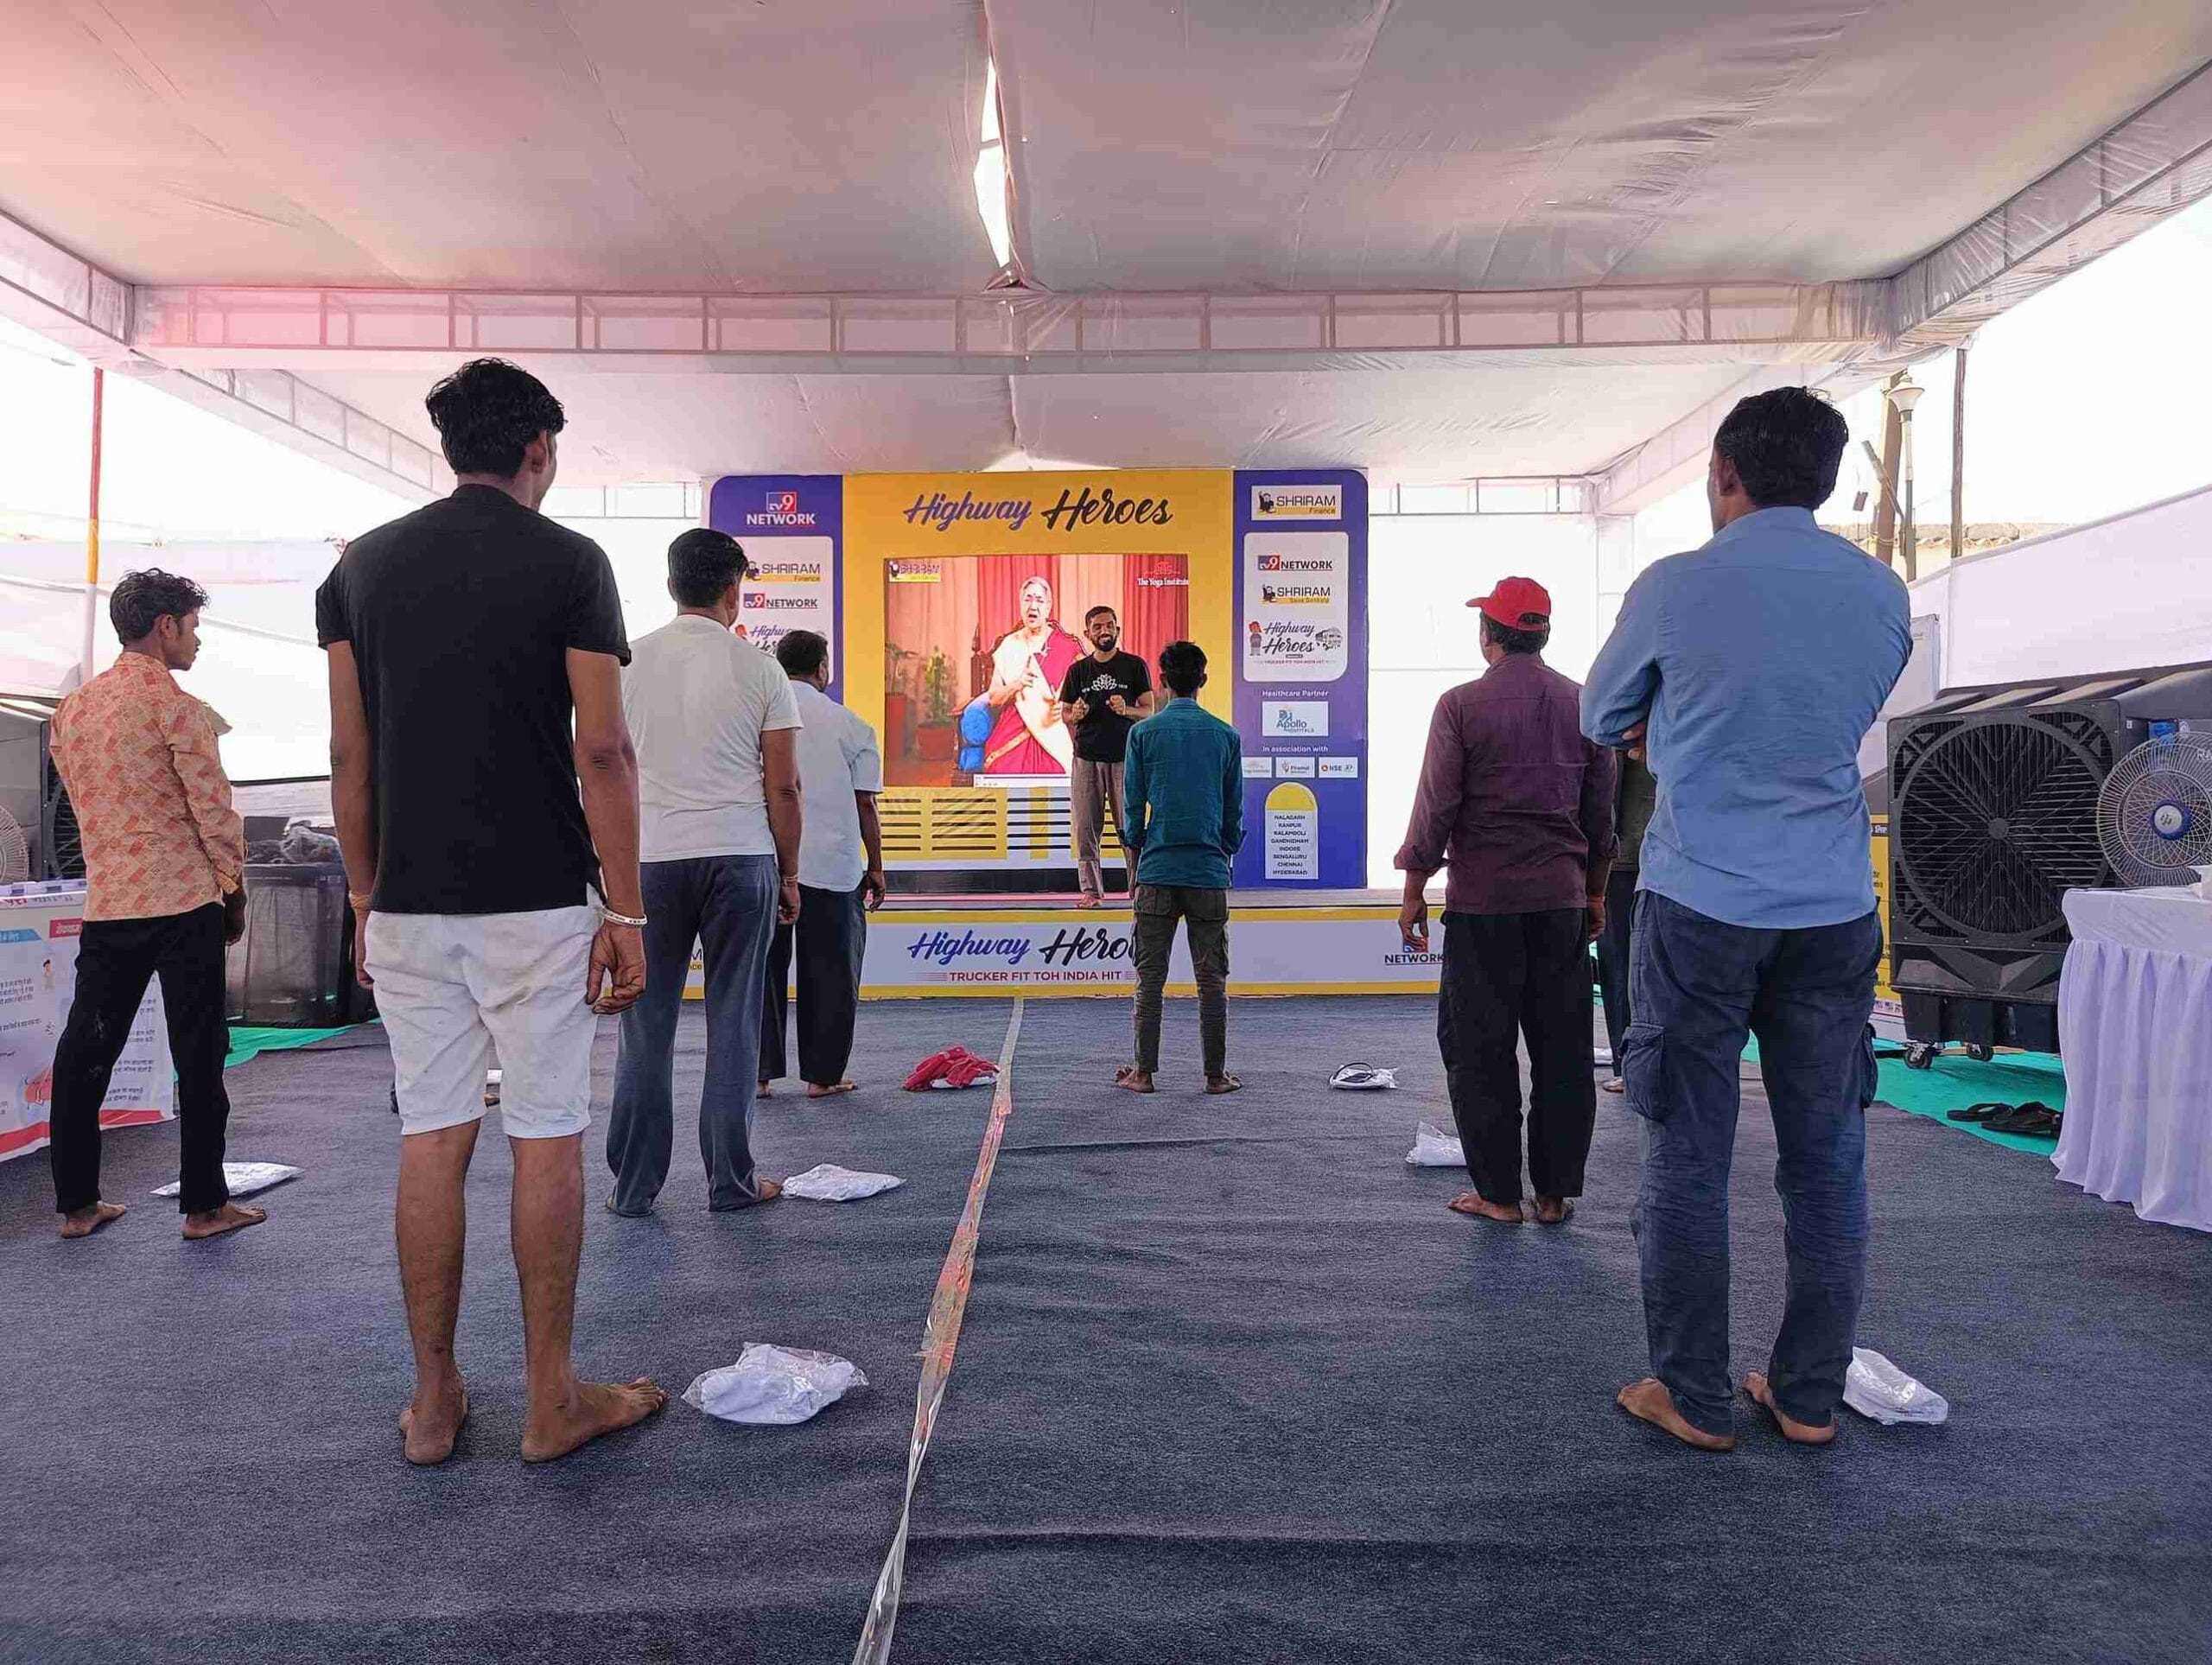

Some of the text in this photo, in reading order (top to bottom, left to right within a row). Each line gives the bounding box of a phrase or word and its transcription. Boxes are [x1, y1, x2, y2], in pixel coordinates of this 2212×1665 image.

[1276, 495, 1336, 506] SHRIRAM
[903, 487, 1173, 531] Highway Heroes
[746, 513, 816, 525] NETWORK
[761, 562, 820, 574] SHRIRAM
[1281, 560, 1332, 570] NETWORK
[1137, 577, 1148, 586] The
[1148, 578, 1163, 588] Yoga
[1277, 586, 1331, 597] SHRIRAM
[766, 598, 818, 607] NETWORK
[1262, 621, 1315, 638] Highway
[1262, 637, 1314, 655] Heroes
[1276, 719, 1307, 730] Apollo
[907, 926, 1135, 967] Highway Hero
[1384, 953, 1444, 963] NETWORK
[950, 970, 1122, 982] TRUCKER FIT TOH INDIA HIT
